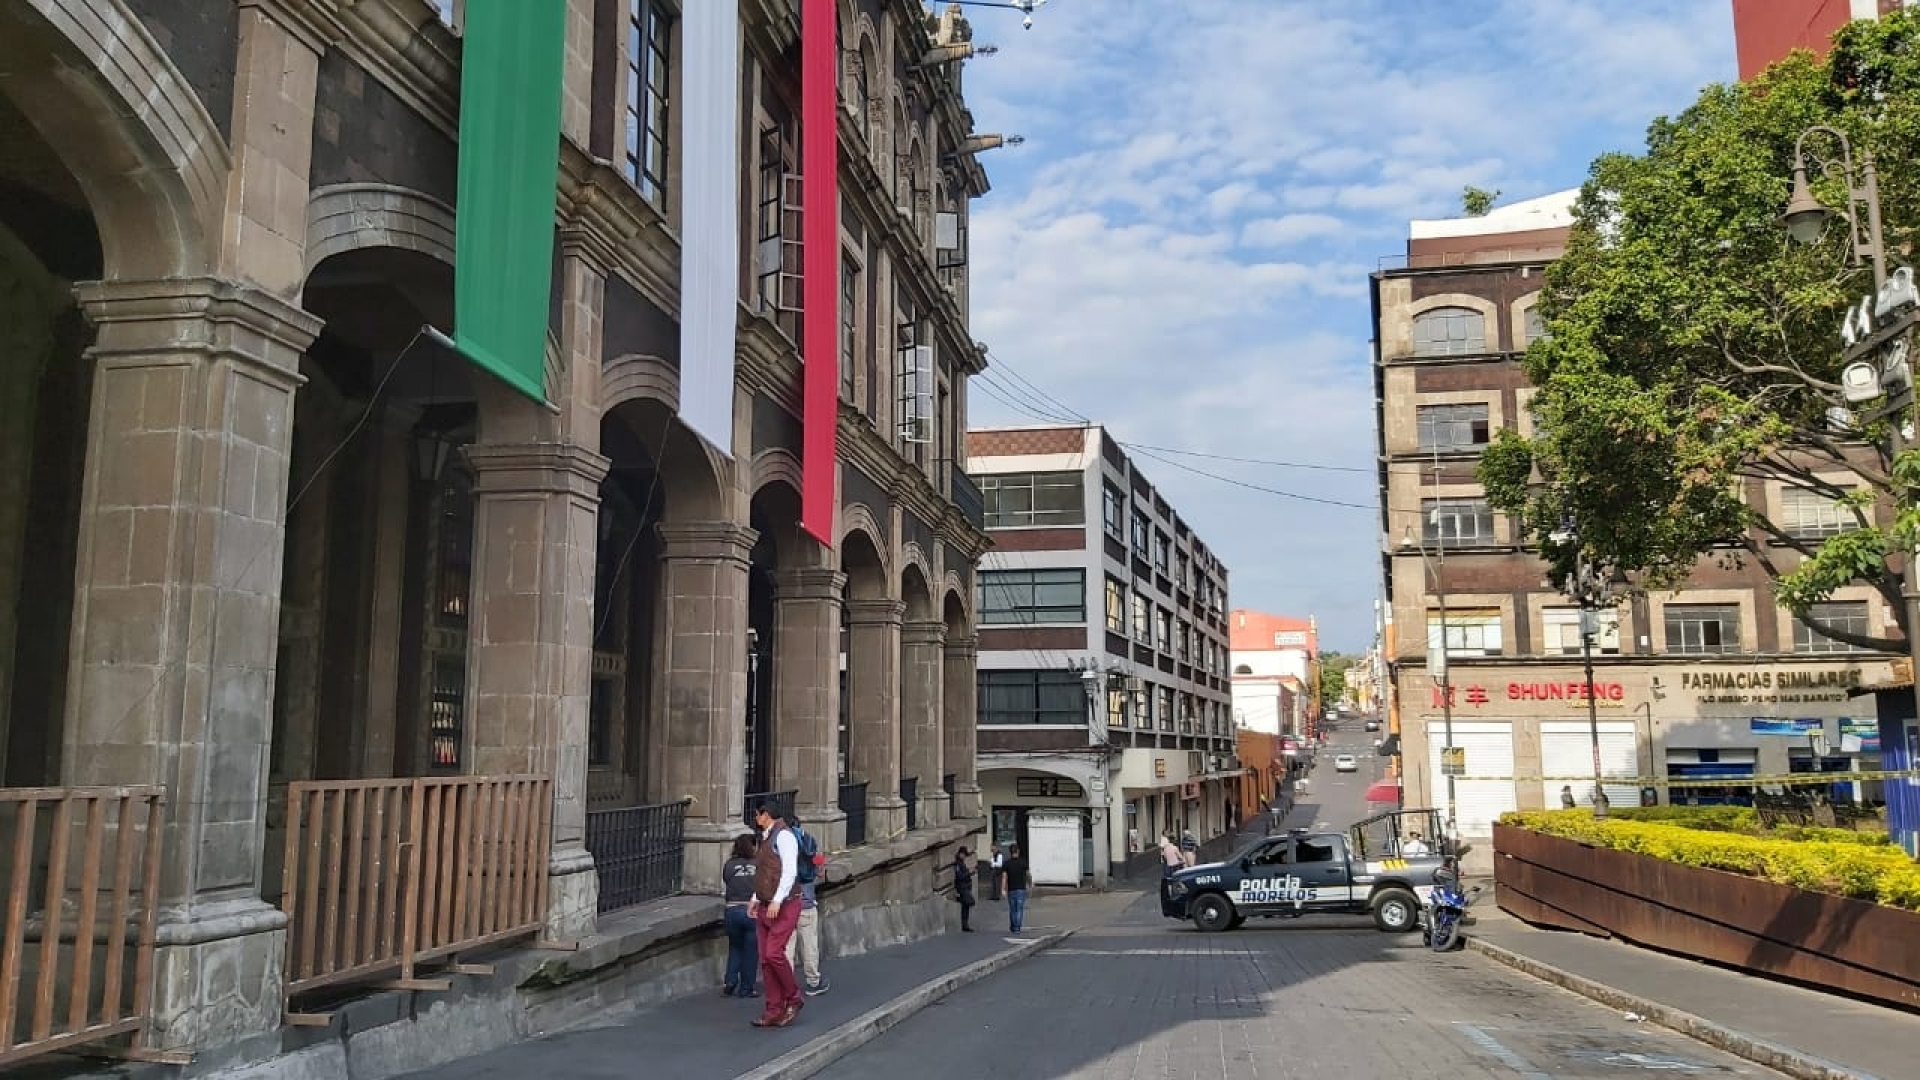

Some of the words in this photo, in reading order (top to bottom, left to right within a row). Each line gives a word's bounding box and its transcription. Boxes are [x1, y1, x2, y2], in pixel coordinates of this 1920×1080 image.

[1682, 672, 1772, 690] FARMACIAS
[1776, 670, 1860, 689] SIMILARES
[1507, 683, 1563, 700] SHUN
[734, 864, 757, 877] 23
